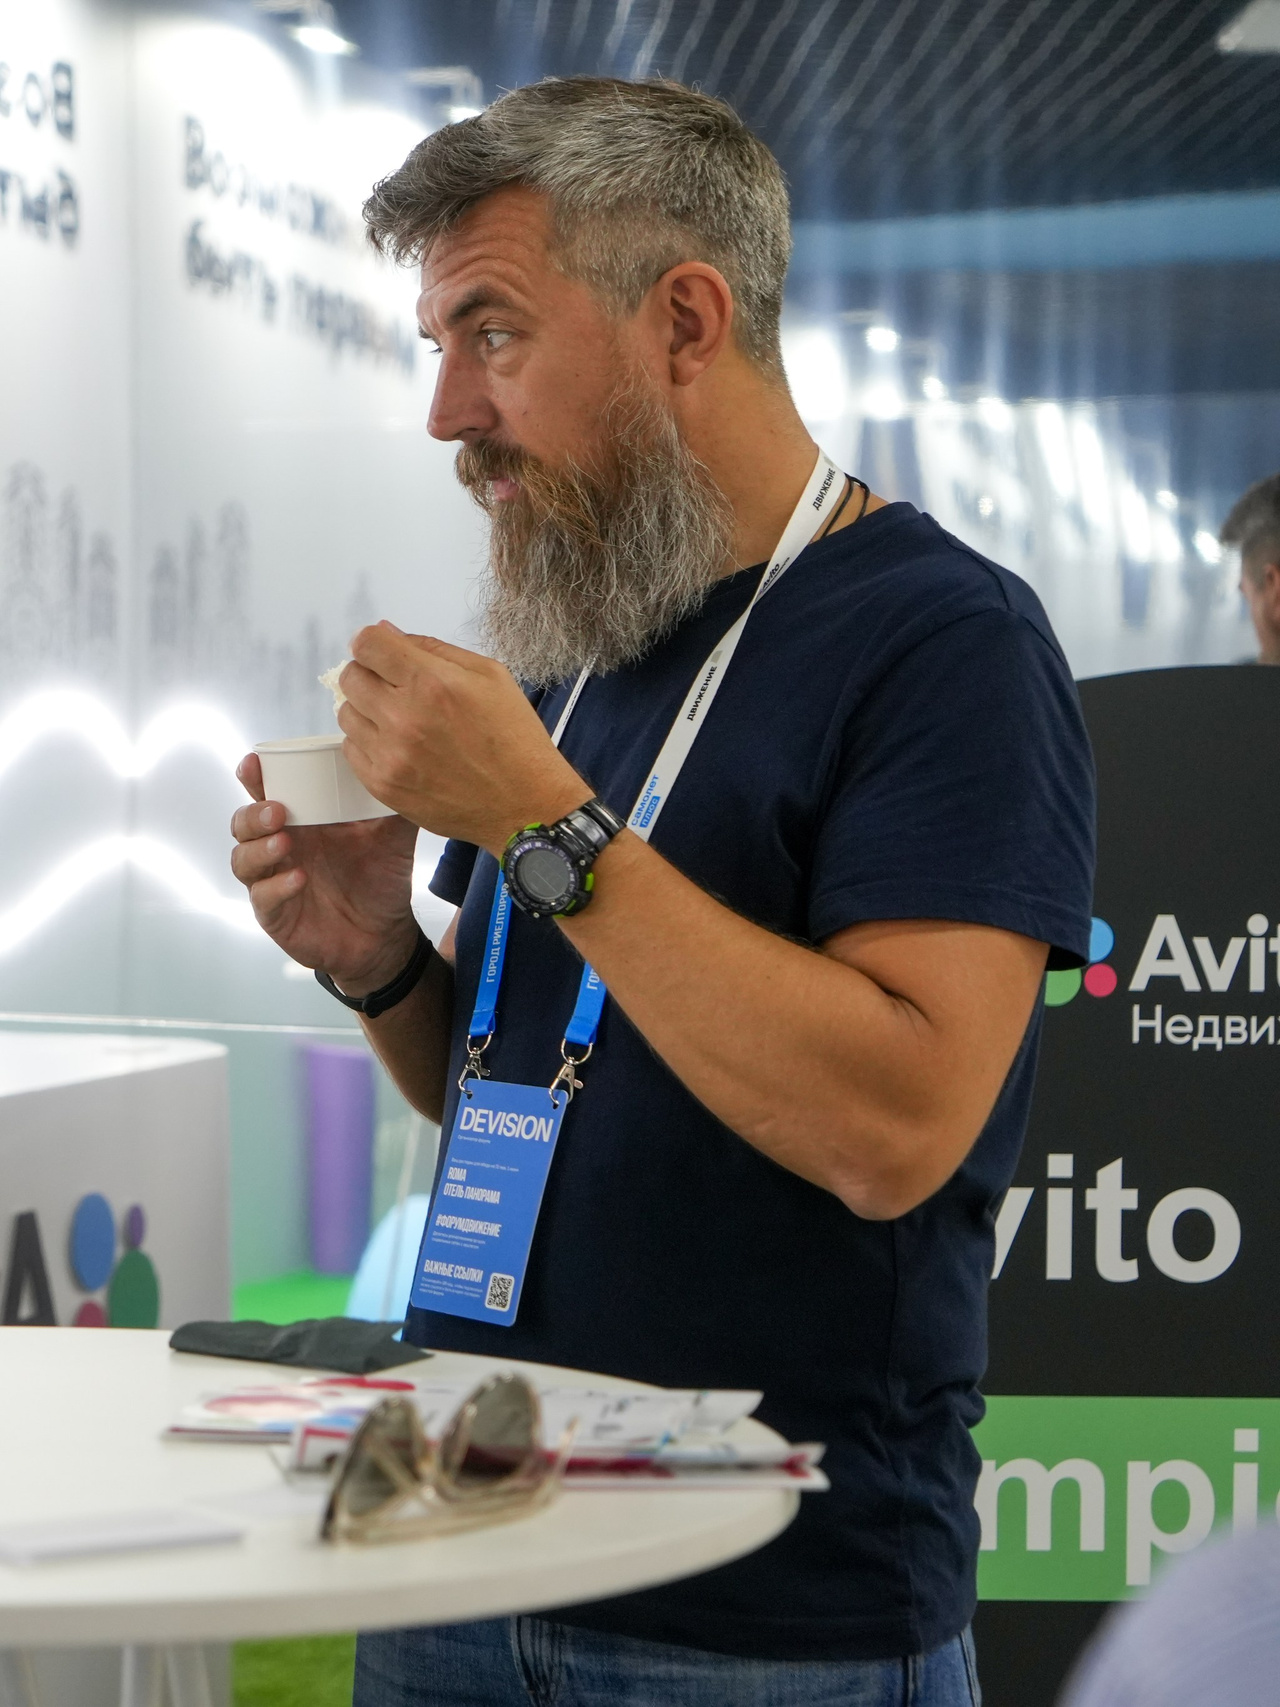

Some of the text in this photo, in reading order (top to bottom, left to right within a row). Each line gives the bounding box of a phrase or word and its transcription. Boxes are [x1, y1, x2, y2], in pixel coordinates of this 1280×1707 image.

[812, 467, 837, 511] ДВИЖЕНИЕ
[686, 665, 717, 721] ДВИЖЕНИЕ
[631, 774, 659, 826] самолет
[486, 947, 501, 983] ГОРОД
[1132, 1004, 1280, 1051] Недви
[460, 1107, 554, 1142] DEVISION
[443, 1183, 500, 1204] ОТЕЛЬ ПАНОРАМА
[436, 1213, 502, 1237] #ФОРУМДВИЖЕНИЕ
[991, 1153, 1242, 1284] vito
[423, 1259, 484, 1283] ВАЖНЫЕ ССЫЛКИ
